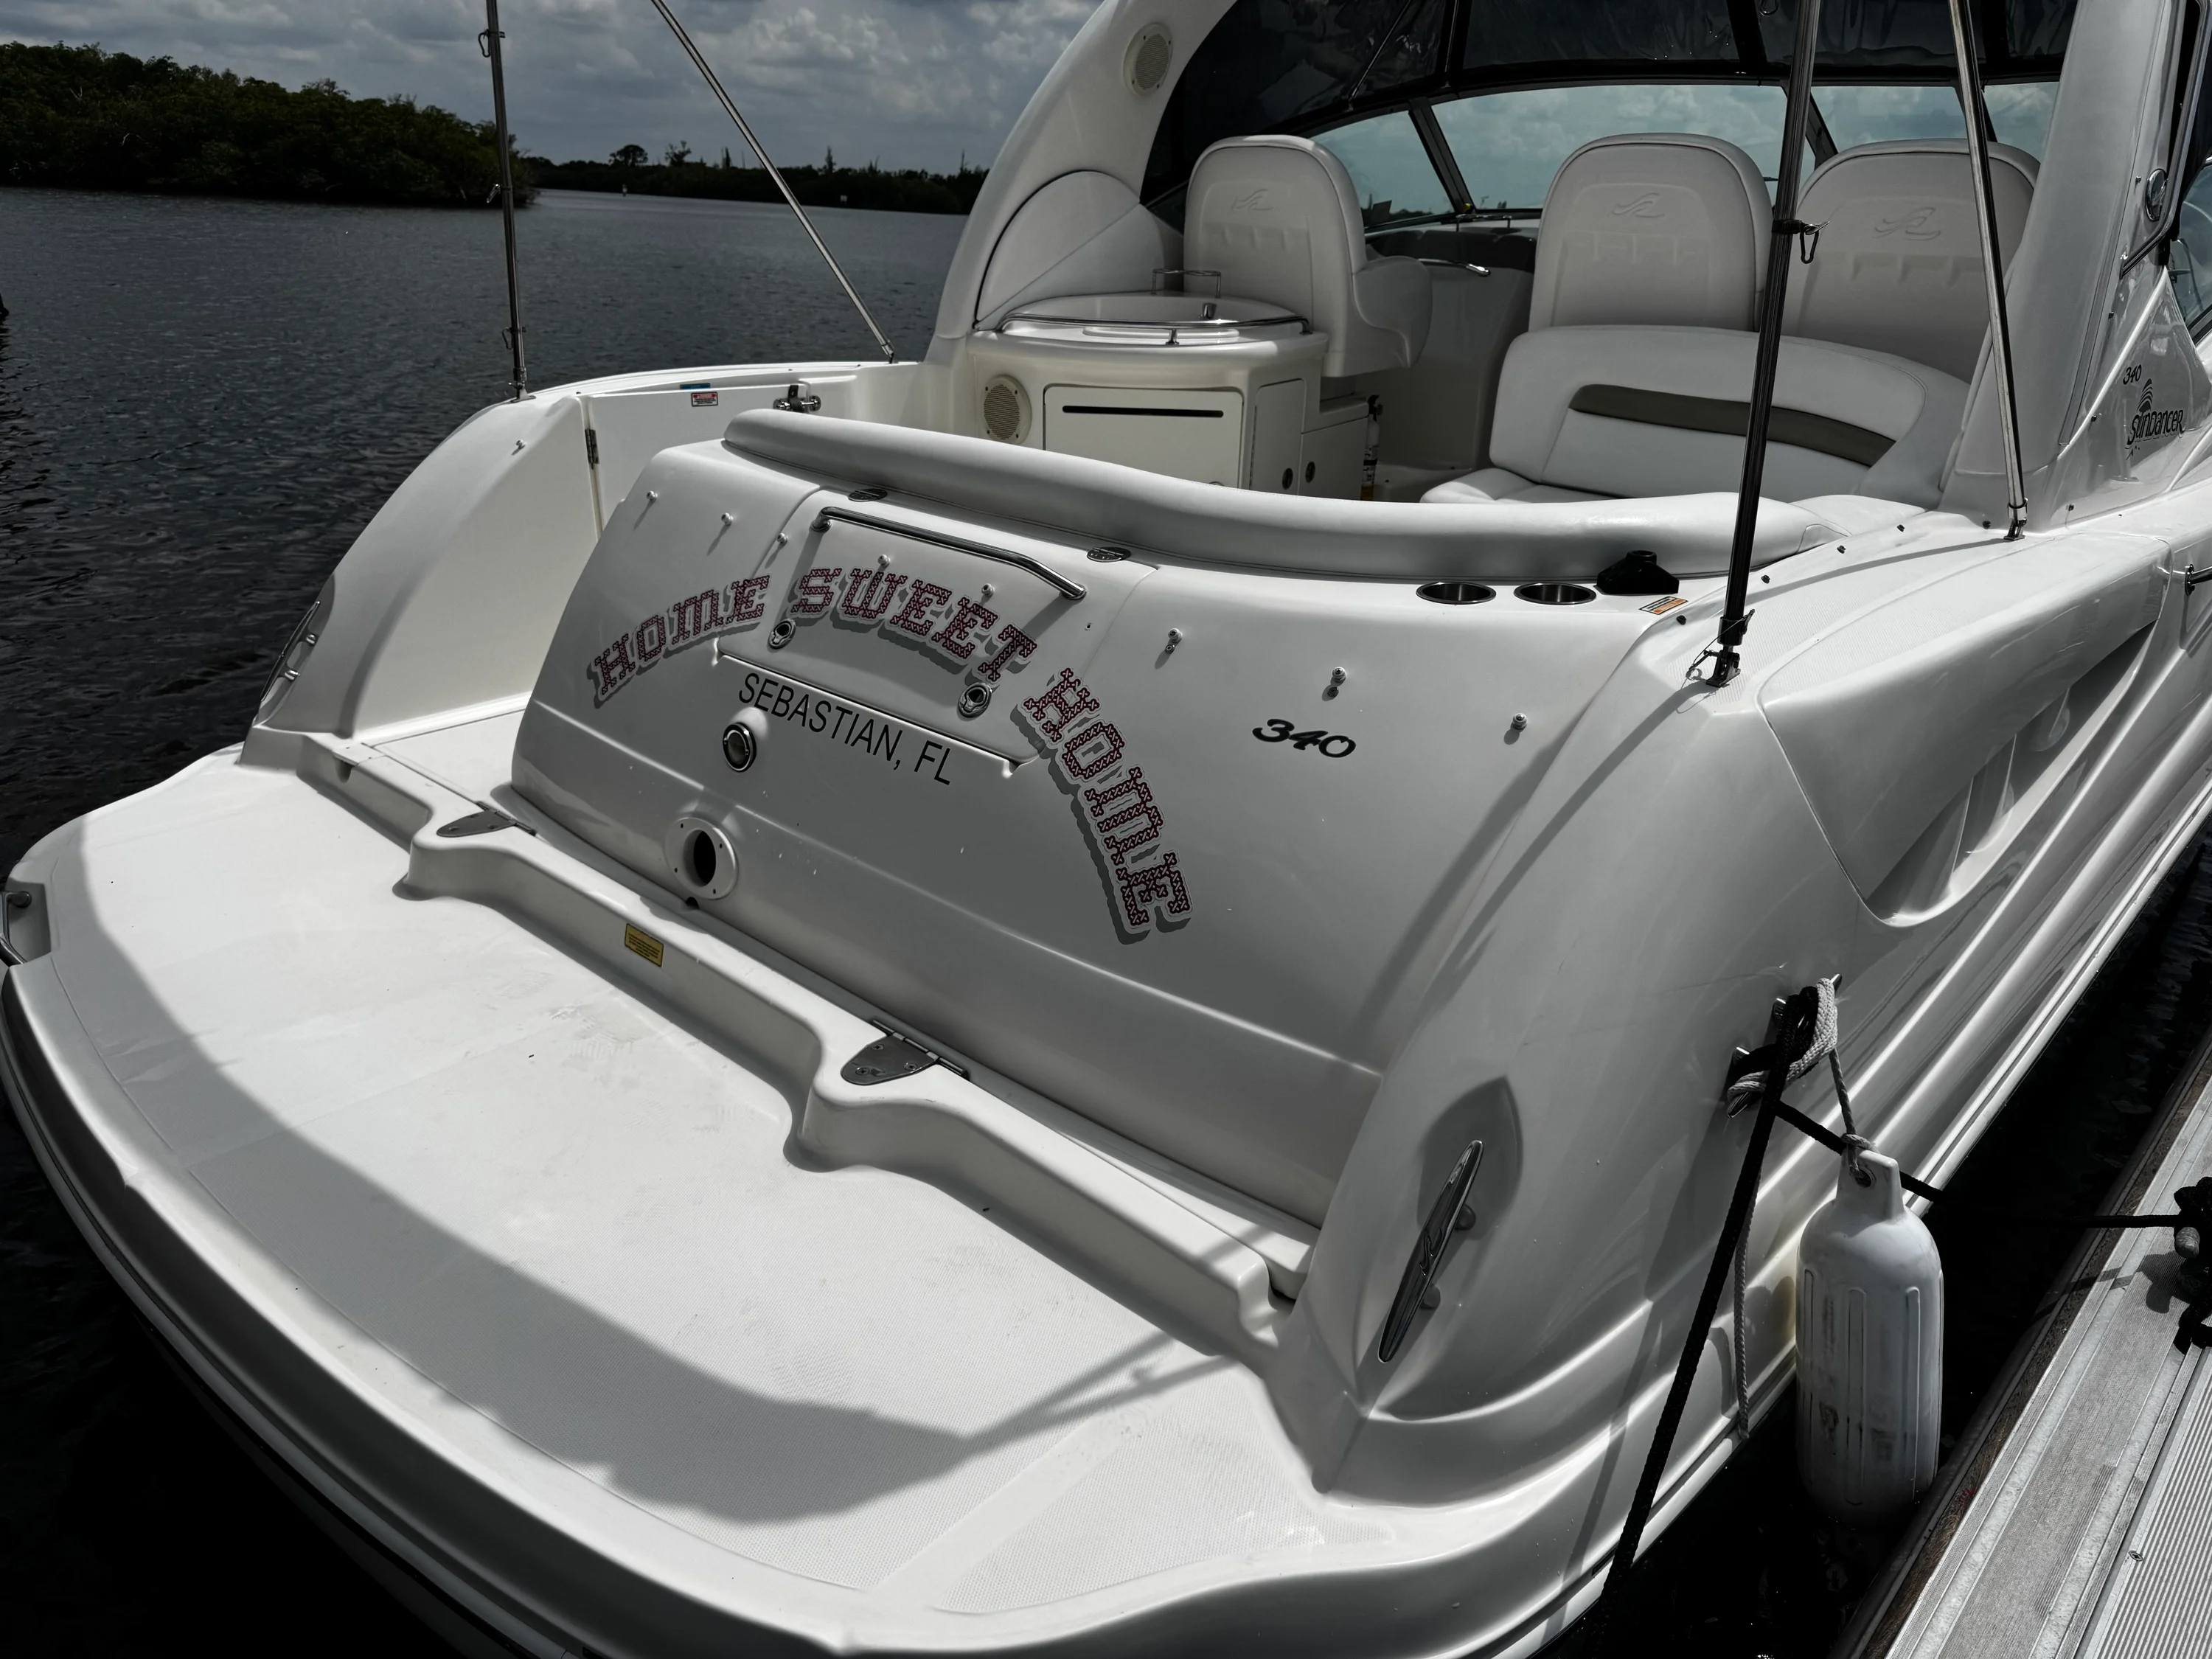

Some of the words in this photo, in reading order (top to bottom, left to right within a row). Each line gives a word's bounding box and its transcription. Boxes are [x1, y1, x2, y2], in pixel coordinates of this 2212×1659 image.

[2123, 364, 2142, 385] 340
[592, 573, 771, 697] HOME
[790, 567, 1037, 682] SWEET
[1023, 667, 1191, 927] HOME
[738, 672, 903, 771] SEBASTIAN,
[914, 740, 951, 786] FL
[1252, 718, 1357, 758] 340
